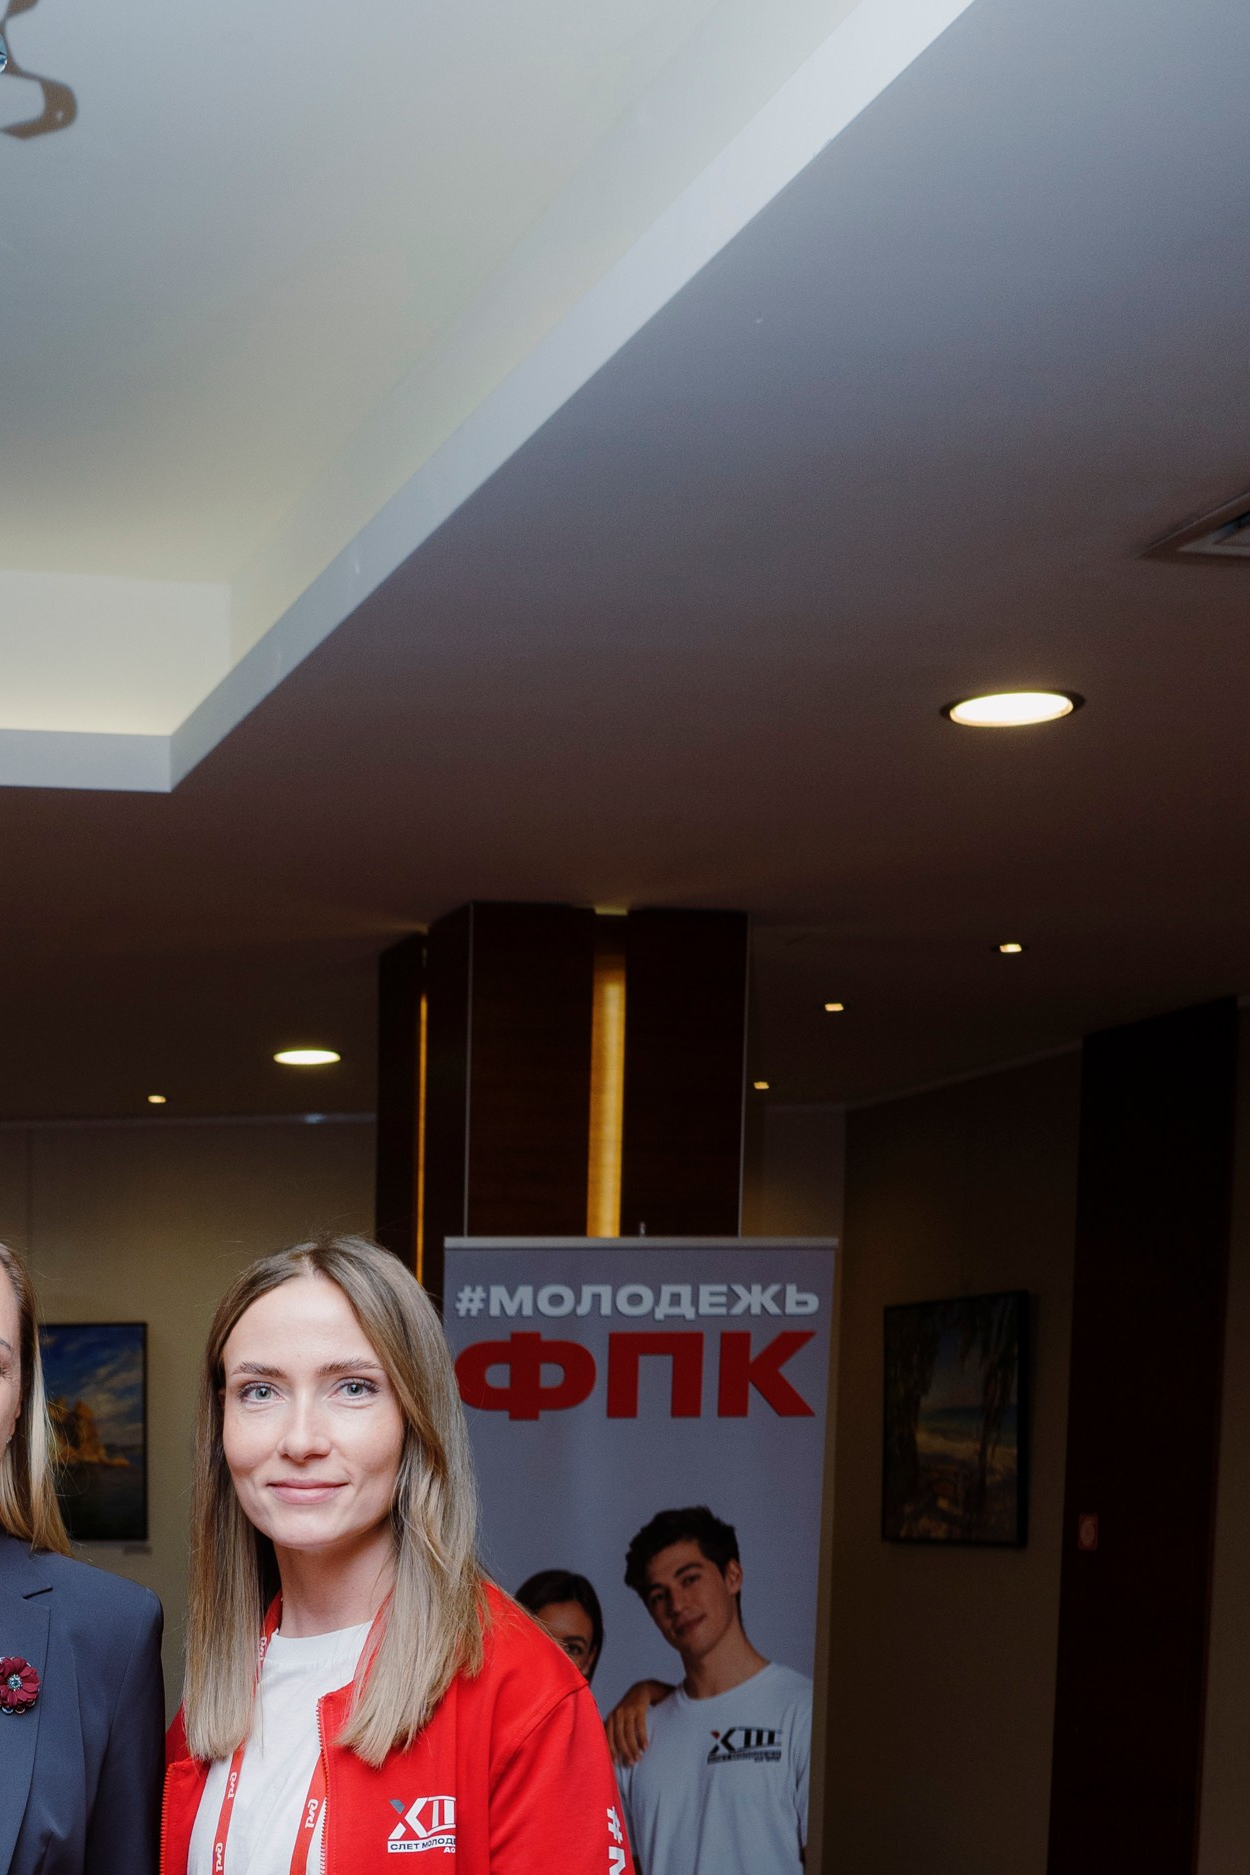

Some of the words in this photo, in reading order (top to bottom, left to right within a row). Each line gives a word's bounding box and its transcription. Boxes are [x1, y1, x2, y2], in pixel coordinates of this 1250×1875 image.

[455, 1283, 820, 1321] #МОЛОДЕЖЬ
[454, 1331, 816, 1420] ФПК
[390, 1843, 420, 1851] СЛЕТ
[421, 1837, 456, 1849] МОЛОД
